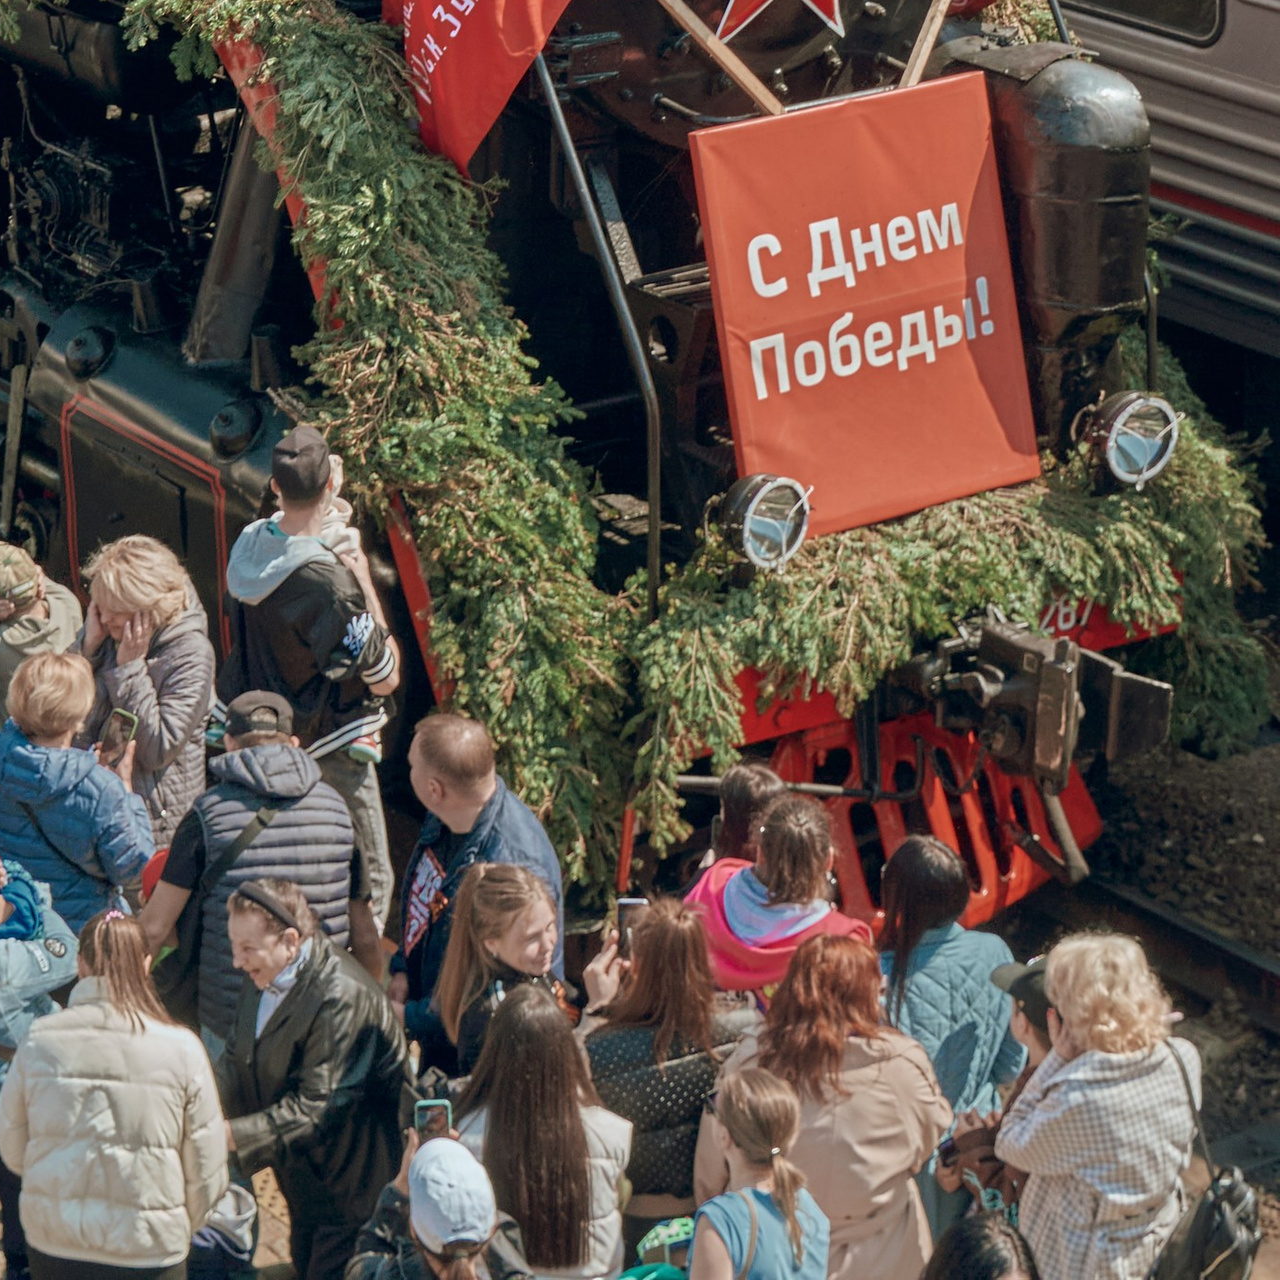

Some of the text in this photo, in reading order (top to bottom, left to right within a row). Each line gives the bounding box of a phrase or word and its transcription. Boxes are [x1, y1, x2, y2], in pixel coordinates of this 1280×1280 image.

[747, 202, 963, 298] С Днем
[749, 276, 994, 400] Победы!
